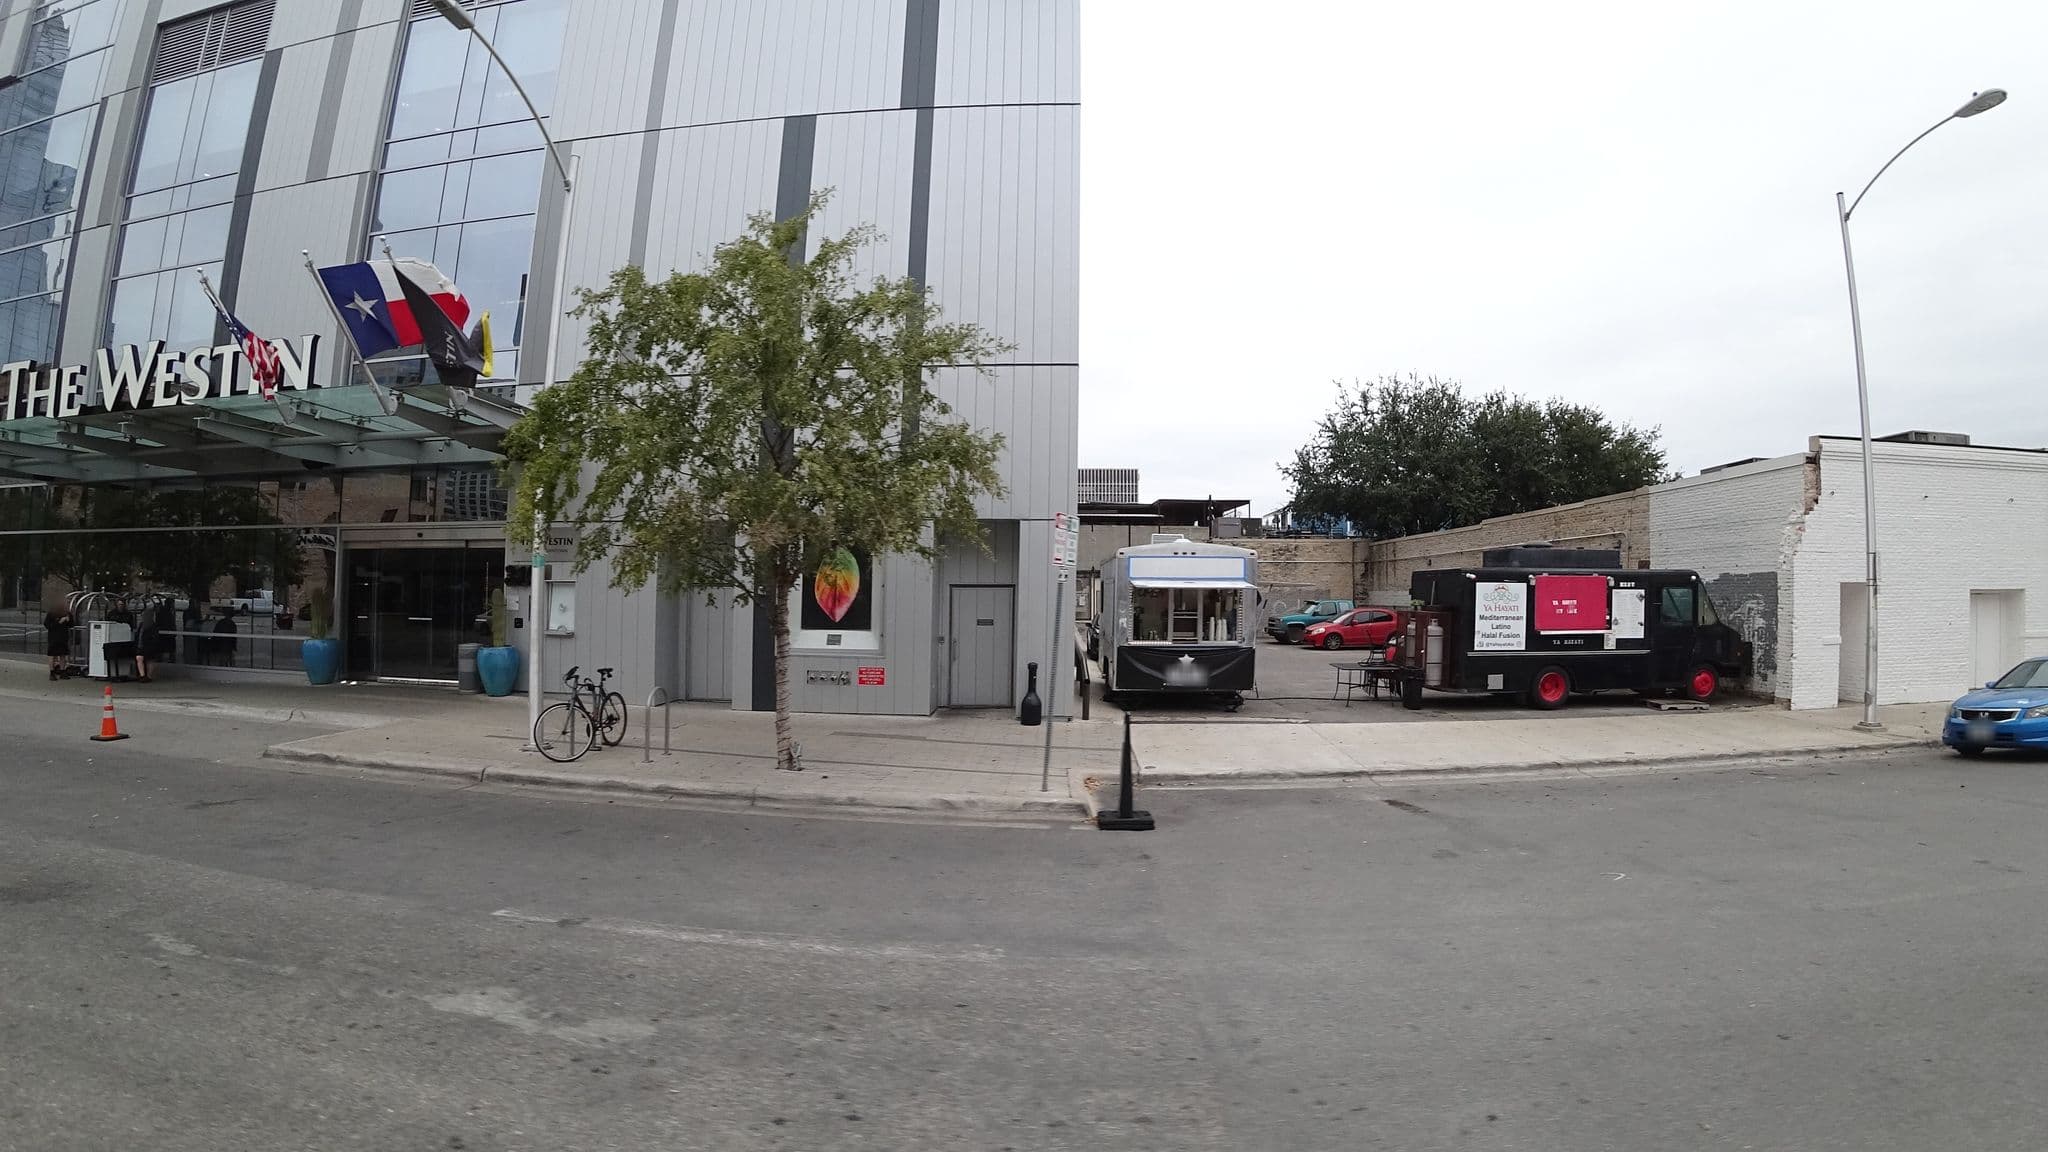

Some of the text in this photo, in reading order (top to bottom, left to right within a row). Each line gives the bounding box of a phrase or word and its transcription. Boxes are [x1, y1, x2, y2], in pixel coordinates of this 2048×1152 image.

[2, 360, 87, 420] THE
[546, 537, 573, 546] ESTIN
[1481, 631, 1521, 639] Halal Fusion
